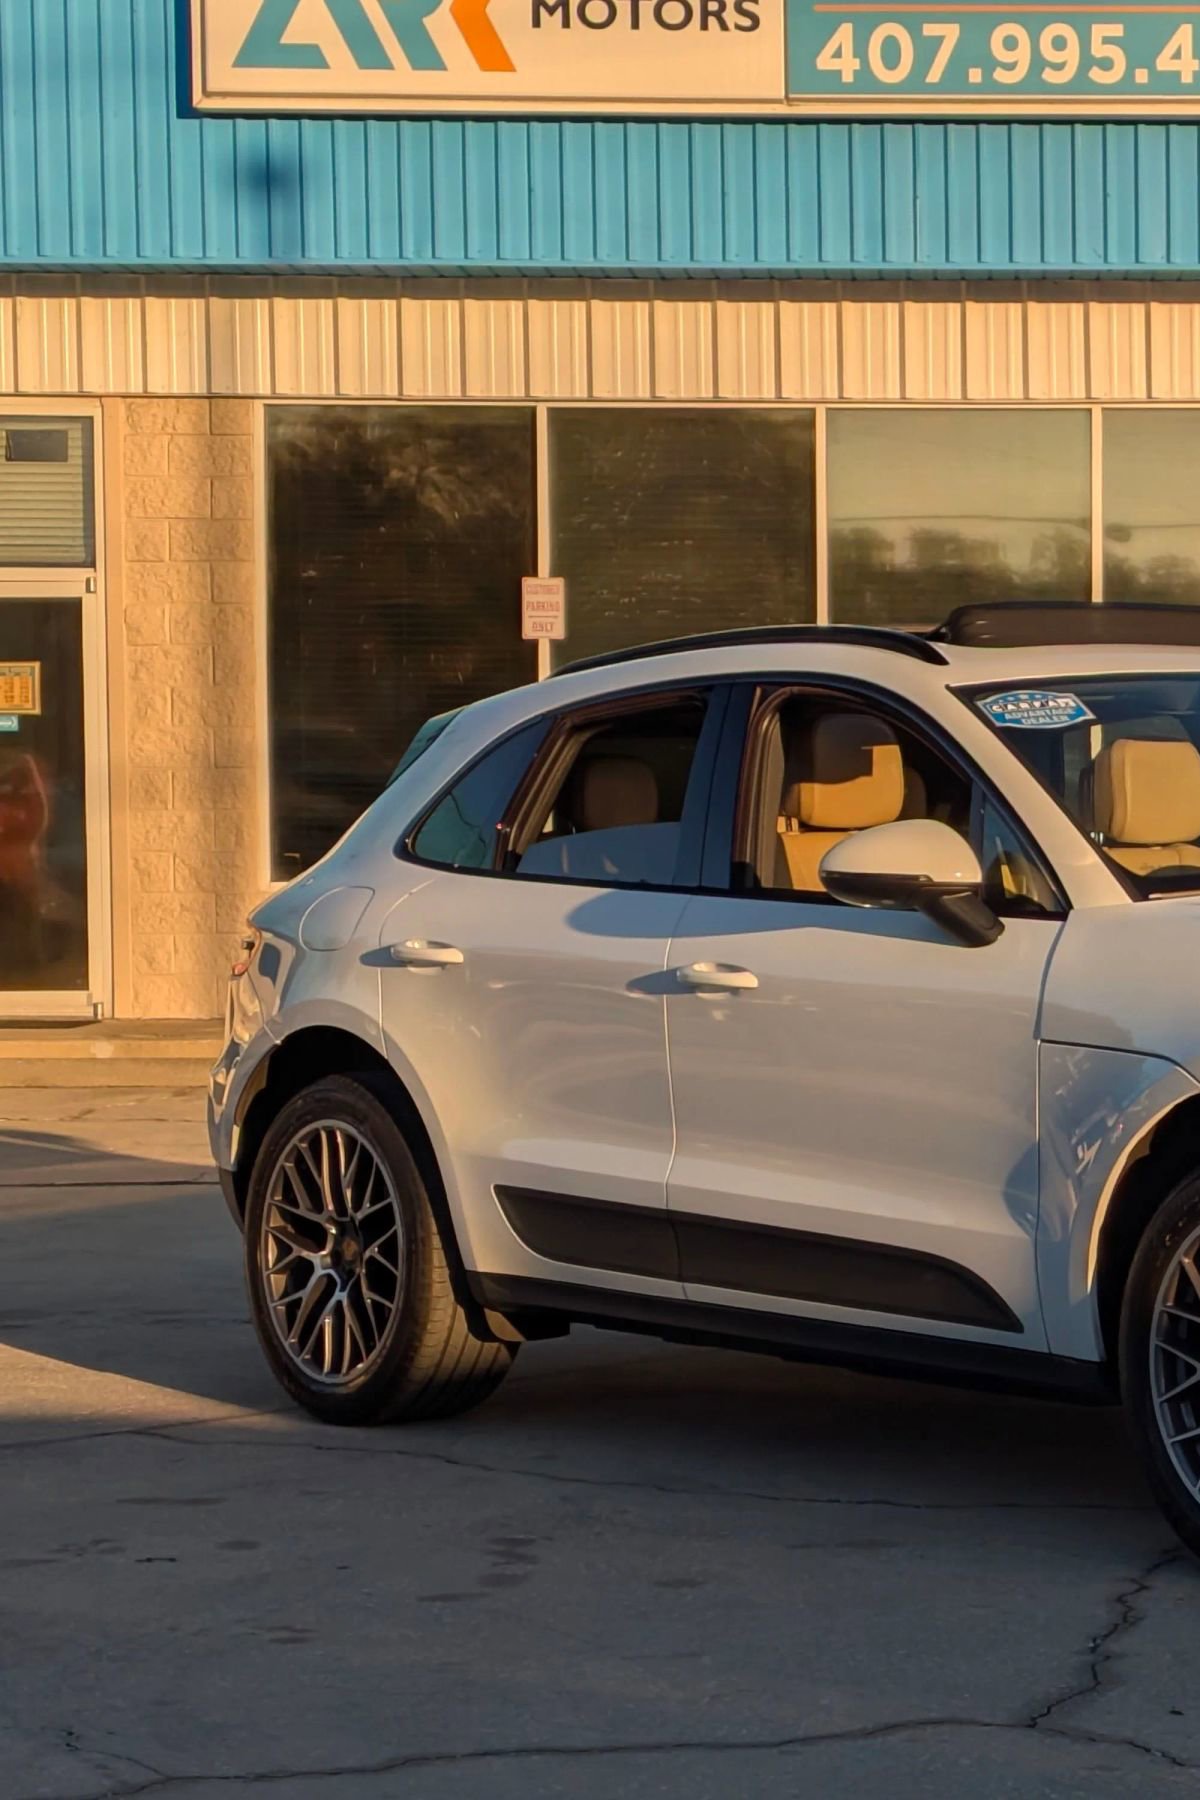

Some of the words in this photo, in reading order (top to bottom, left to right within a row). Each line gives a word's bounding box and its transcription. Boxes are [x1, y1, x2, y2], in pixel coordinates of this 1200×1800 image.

[531, 0, 760, 32] MOTORS
[526, 600, 560, 612] PARKING
[991, 698, 1077, 712] CARFAX
[1004, 707, 1076, 720] ADVANTAGE
[1021, 715, 1070, 725] DEALER
